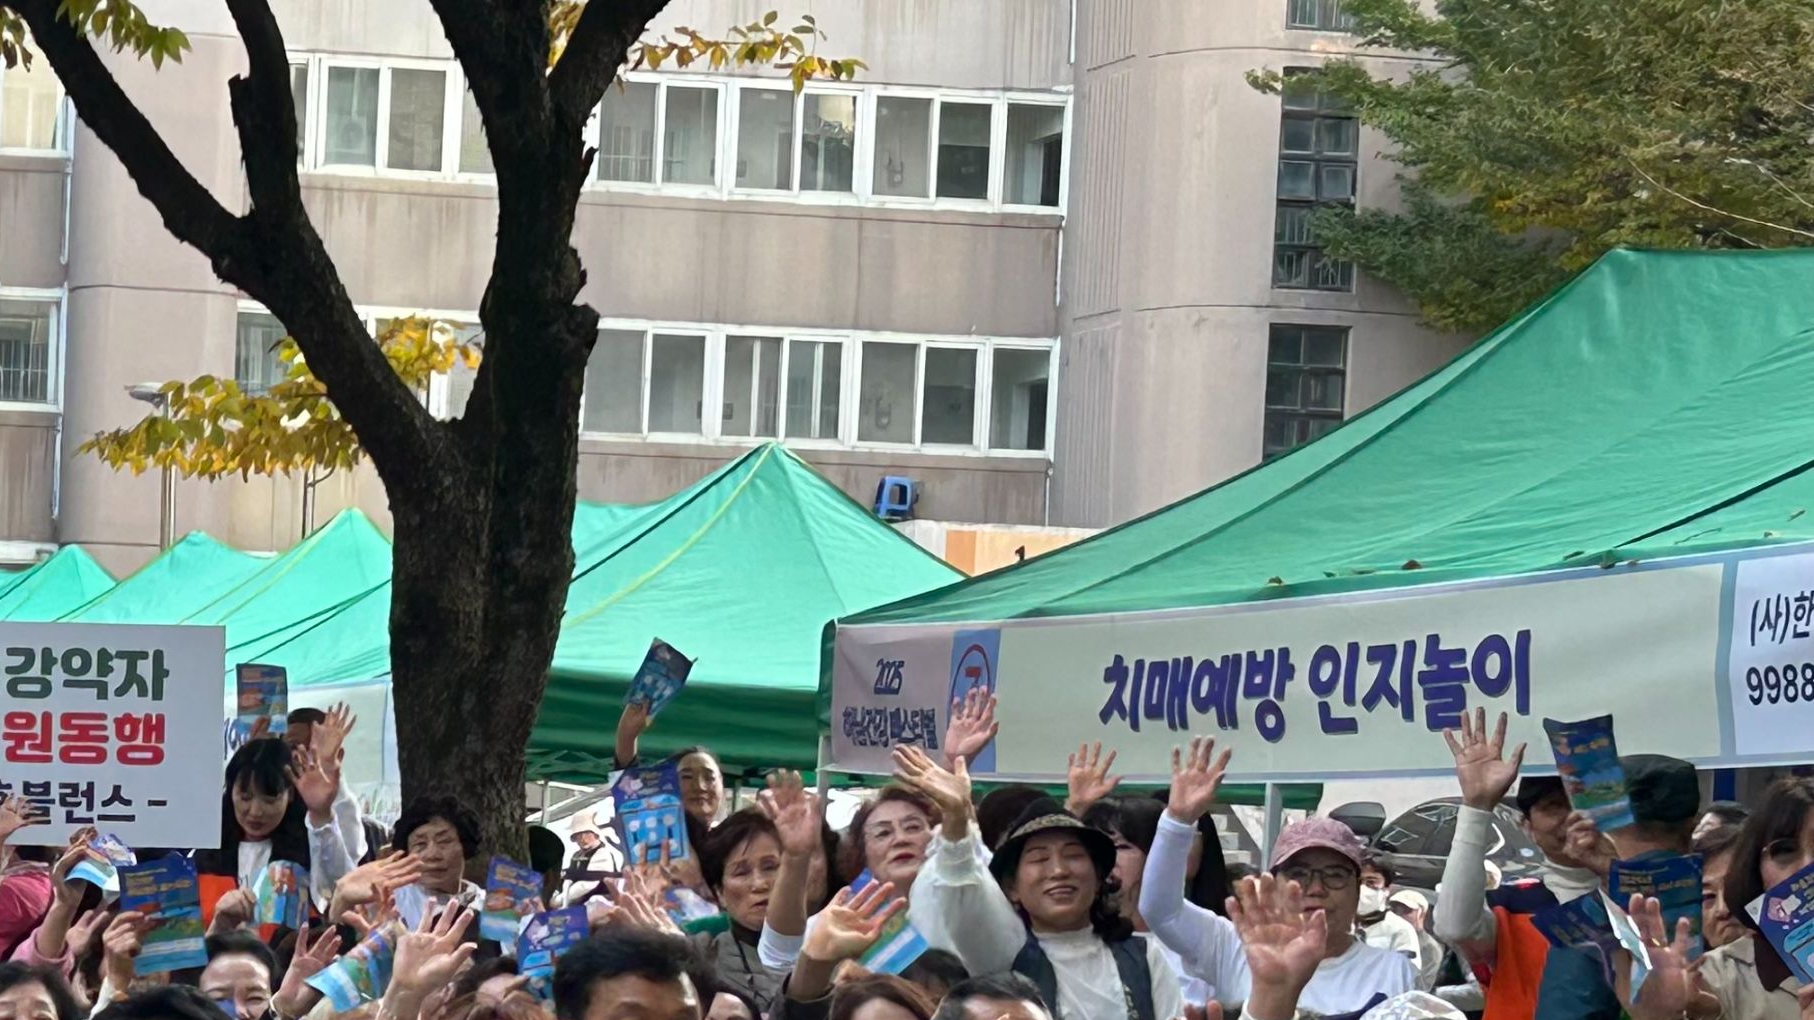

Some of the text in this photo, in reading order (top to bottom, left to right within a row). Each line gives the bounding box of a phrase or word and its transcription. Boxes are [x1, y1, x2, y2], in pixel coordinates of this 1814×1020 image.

[1098, 629, 1531, 744] 치매예방 인지놀이
[1746, 662, 1814, 706] 9988
